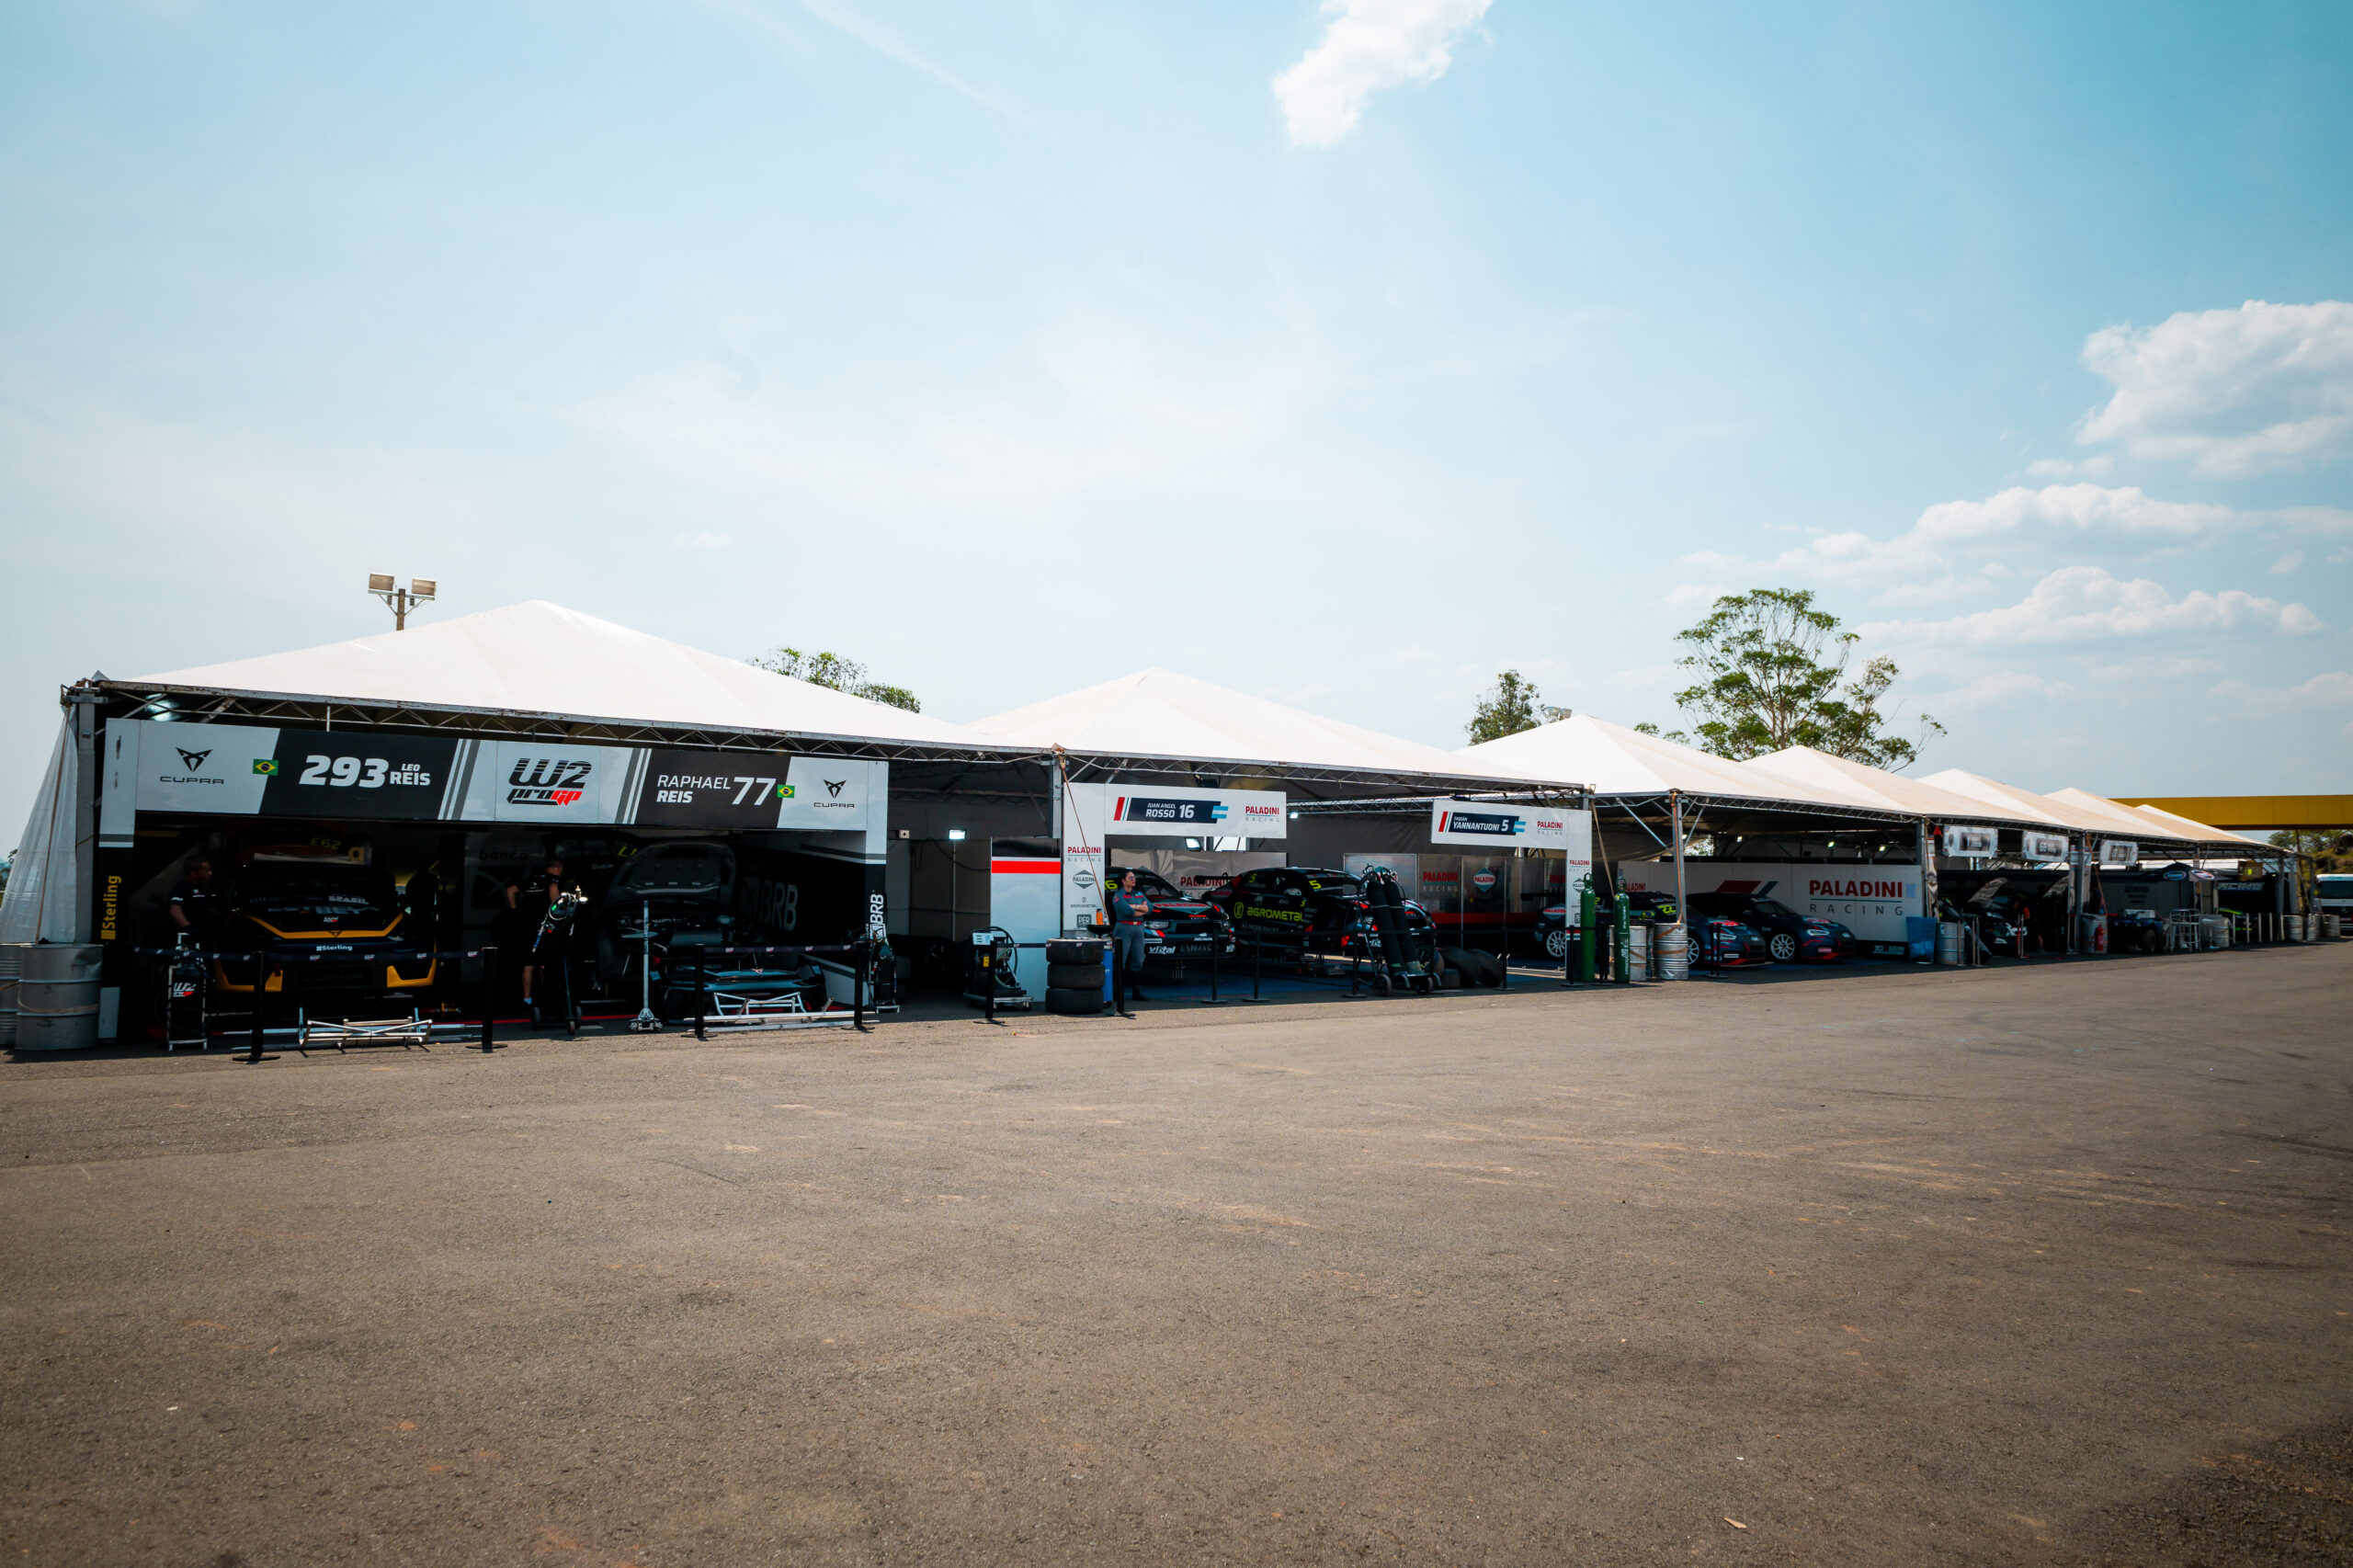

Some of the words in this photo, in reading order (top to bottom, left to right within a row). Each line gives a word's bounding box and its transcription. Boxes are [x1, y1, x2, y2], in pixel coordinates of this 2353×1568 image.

[299, 754, 390, 788] 293
[401, 763, 420, 772] LEO
[160, 776, 224, 784] CUPRA
[390, 771, 431, 787] REIS
[656, 773, 731, 790] RAPHAEL
[656, 790, 694, 804] REIS
[731, 777, 777, 806] 77
[1145, 809, 1176, 818] ROSSO
[1179, 804, 1195, 819] 16
[1245, 805, 1279, 815] PALADINI
[1453, 822, 1500, 832] YANNANTUONI
[1501, 820, 1509, 832] 5
[1537, 821, 1563, 829] PALADINI
[1423, 871, 1458, 882] PALADINI
[1810, 880, 1903, 897] PALADINI
[102, 875, 122, 929] Sterling
[758, 878, 800, 932] BRB
[870, 892, 884, 924] BRB
[1810, 903, 1904, 915] RACING
